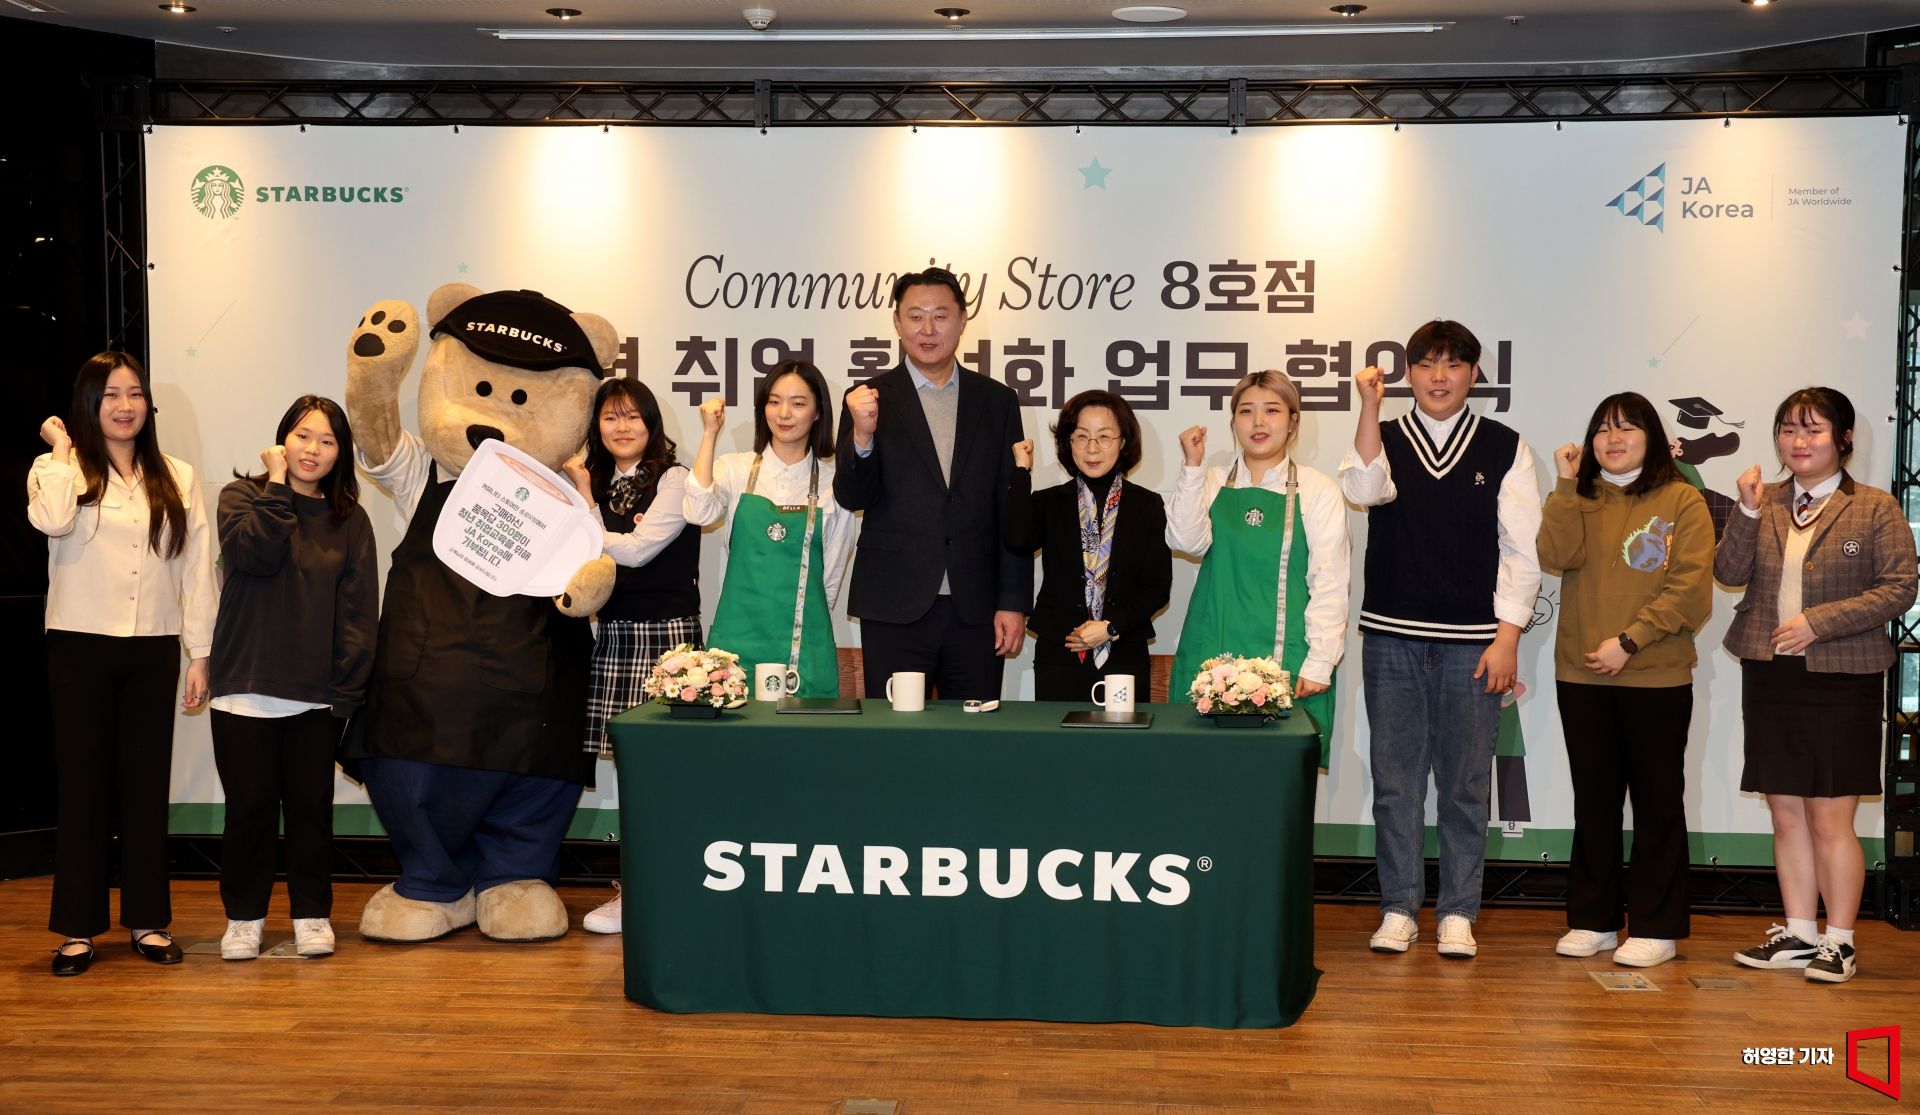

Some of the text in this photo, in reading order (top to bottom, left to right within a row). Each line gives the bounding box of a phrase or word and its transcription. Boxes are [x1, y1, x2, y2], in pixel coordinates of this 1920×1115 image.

[1680, 176, 1712, 195] JA
[1788, 187, 1840, 196] Member of
[1788, 196, 1852, 206] JA Worldwide
[1681, 200, 1754, 219] Korea
[998, 256, 1136, 311] Store
[1160, 259, 1316, 314] 8호점
[466, 321, 563, 353] STARBUCKS
[1104, 339, 1250, 411] 업무
[471, 503, 531, 547] 품목당 300원이
[491, 503, 524, 530] 구매하신
[458, 507, 477, 524] 청년
[513, 544, 532, 561] 위해
[463, 526, 477, 538] JA
[476, 533, 514, 562] Korea에
